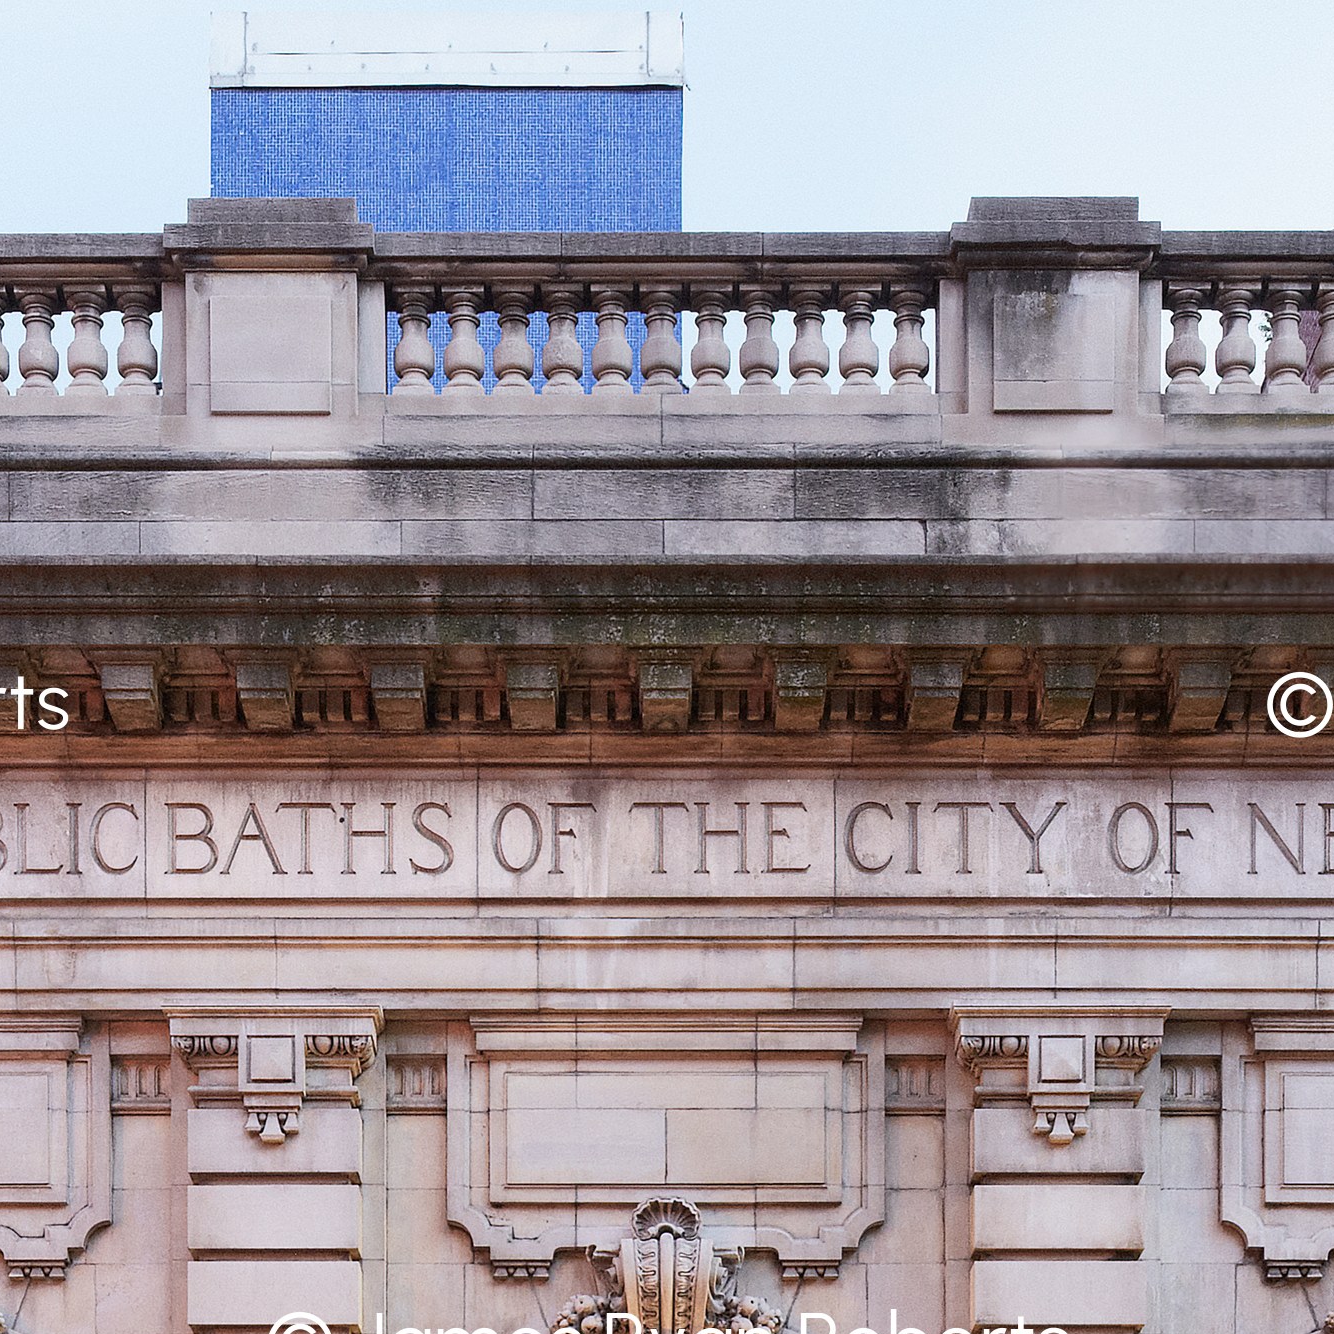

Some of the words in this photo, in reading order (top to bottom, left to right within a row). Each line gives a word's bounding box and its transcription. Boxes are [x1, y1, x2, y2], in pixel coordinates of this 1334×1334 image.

[163, 802, 454, 875] BATHS
[491, 801, 598, 875] OF
[628, 801, 812, 875] THE
[843, 801, 1068, 875] CITY
[1107, 801, 1215, 875] OF
